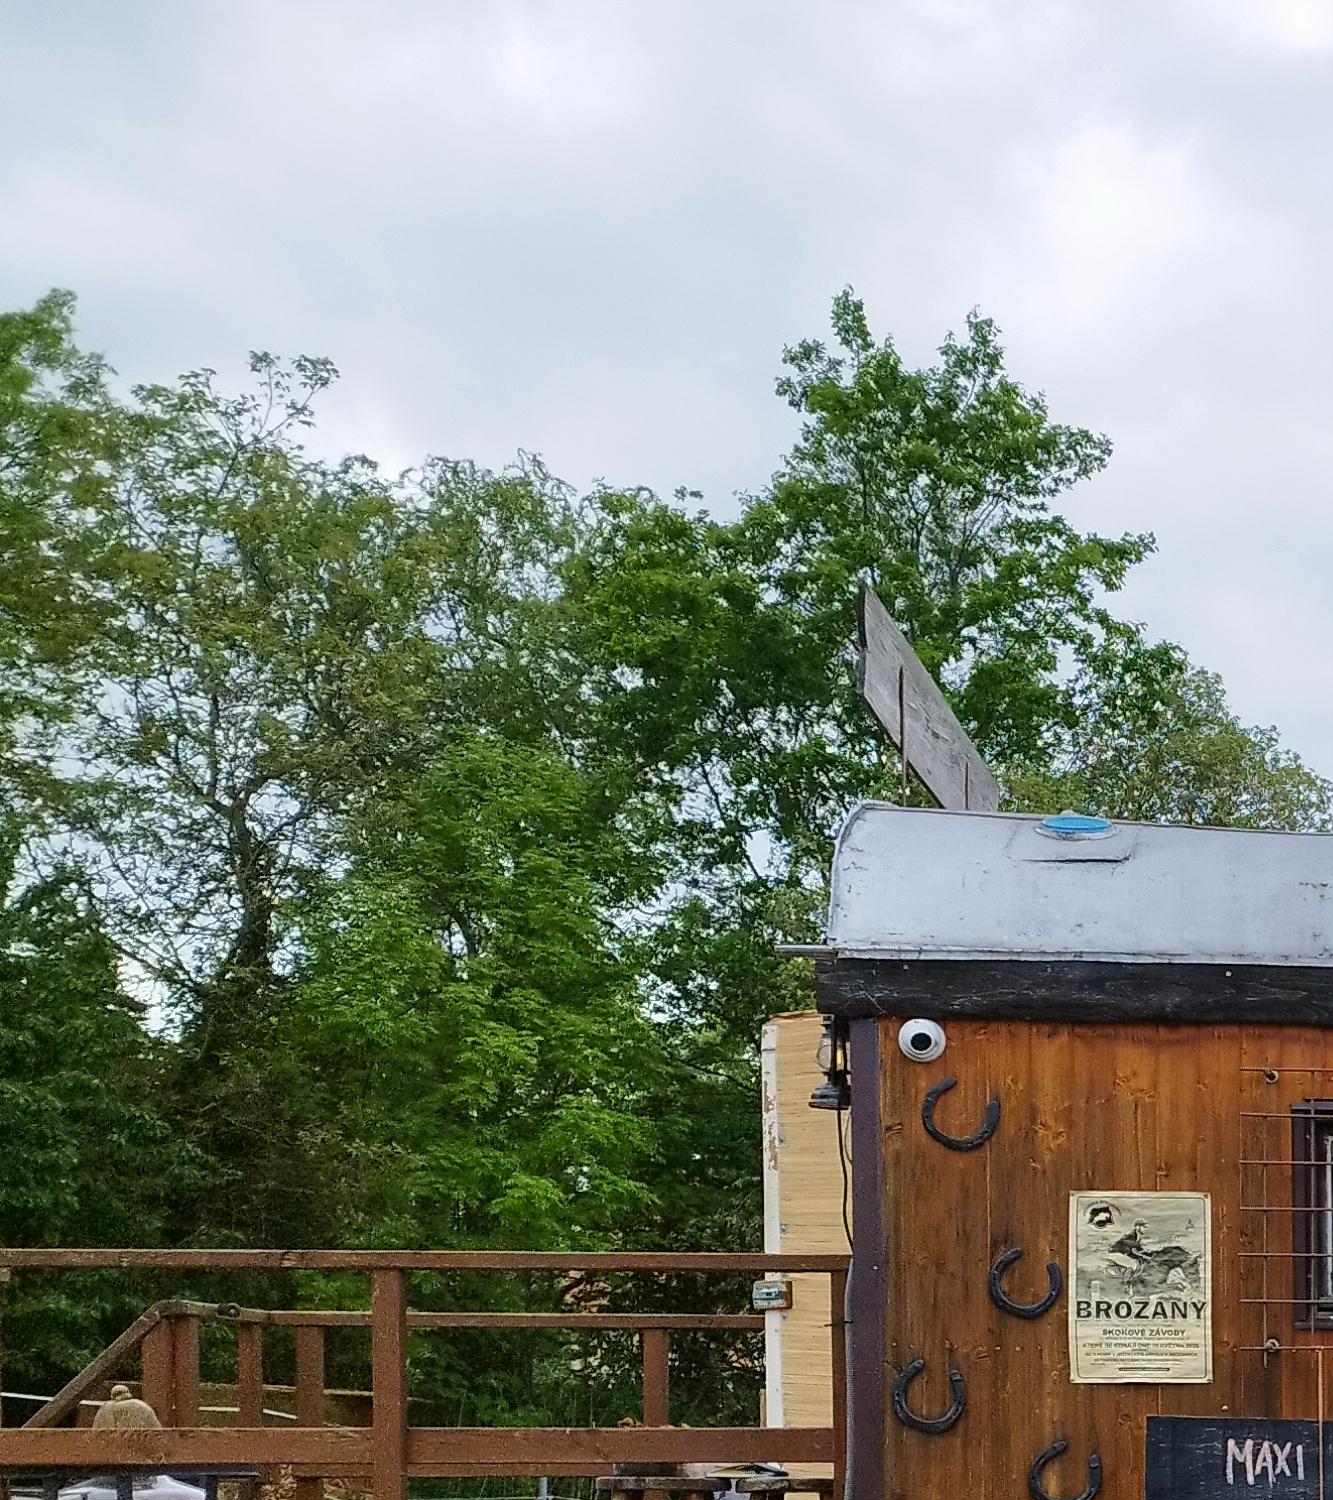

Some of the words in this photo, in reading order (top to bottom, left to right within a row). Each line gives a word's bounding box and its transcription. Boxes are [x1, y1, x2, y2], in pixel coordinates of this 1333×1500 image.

[1076, 1300, 1206, 1320] BROZANY
[1149, 1327, 1186, 1336] ZÁVODY
[1226, 1438, 1305, 1488] MAXI
